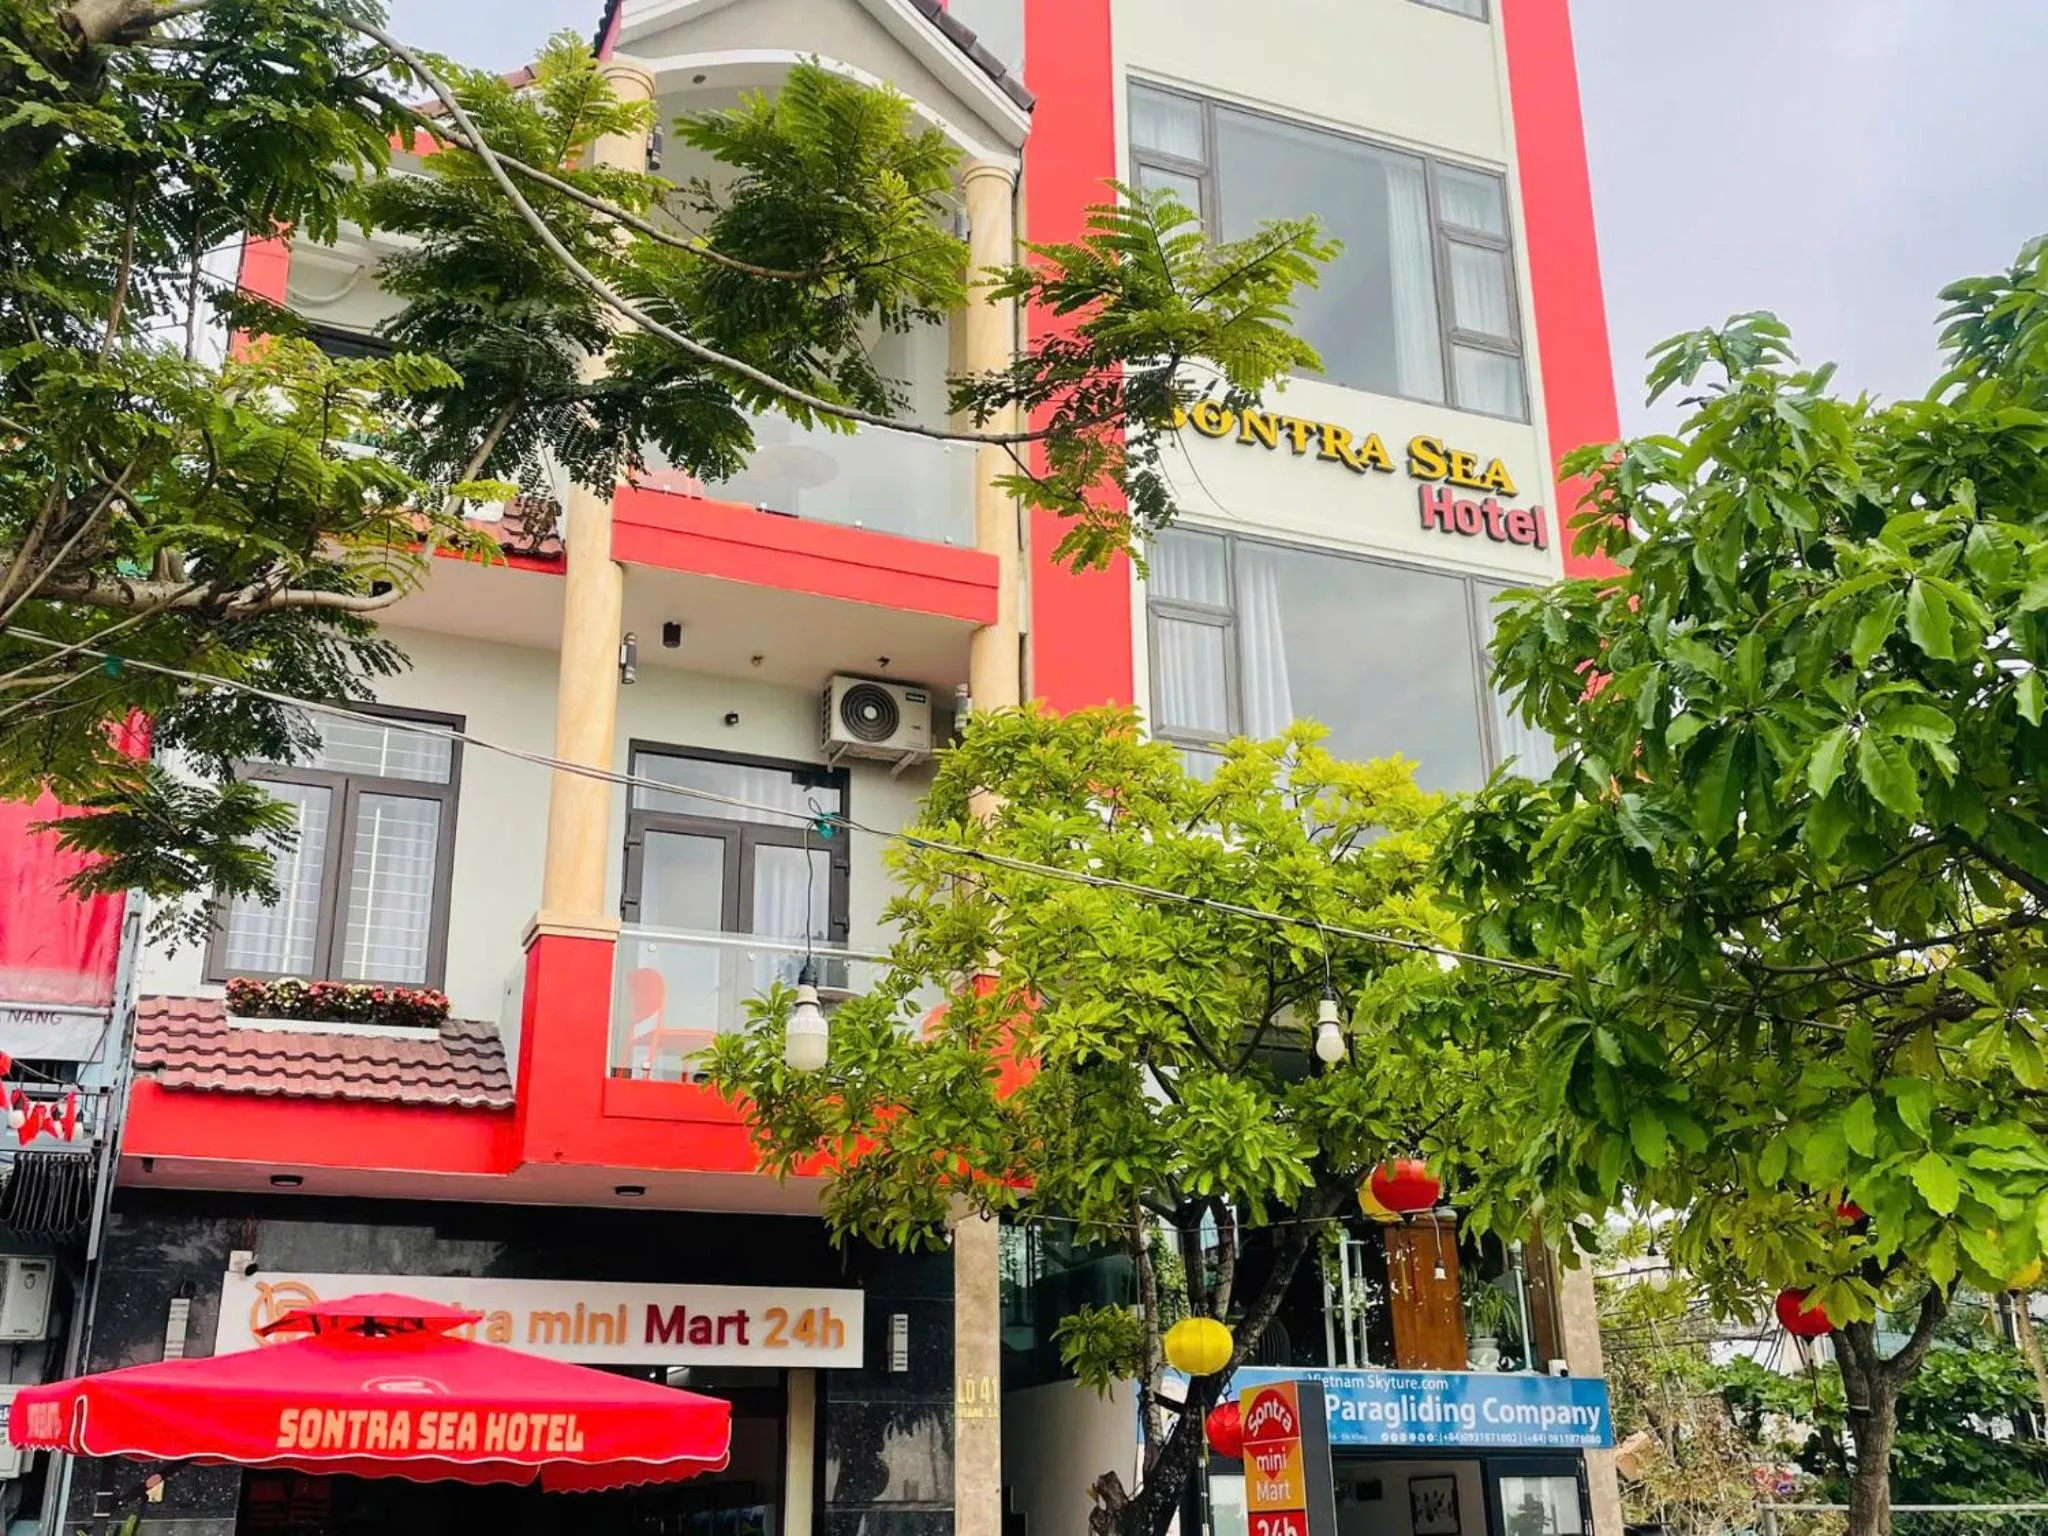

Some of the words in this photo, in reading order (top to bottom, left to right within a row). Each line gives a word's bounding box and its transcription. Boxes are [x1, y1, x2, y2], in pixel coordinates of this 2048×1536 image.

[1406, 434, 1518, 497] SEA
[1419, 484, 1548, 550] Hotel
[527, 1302, 629, 1346] mini
[644, 1304, 750, 1347] Mart
[762, 1306, 846, 1350] 24h
[1367, 1375, 1449, 1392] Skyture.com
[277, 1408, 410, 1449] SONTRA
[416, 1411, 477, 1450] SEA
[484, 1413, 584, 1452] HOTEL
[1248, 1398, 1293, 1437] Sontra
[1326, 1393, 1476, 1429] Paragliding
[1482, 1397, 1601, 1432] Company
[1256, 1446, 1288, 1472] mini
[1256, 1480, 1292, 1502] Mart
